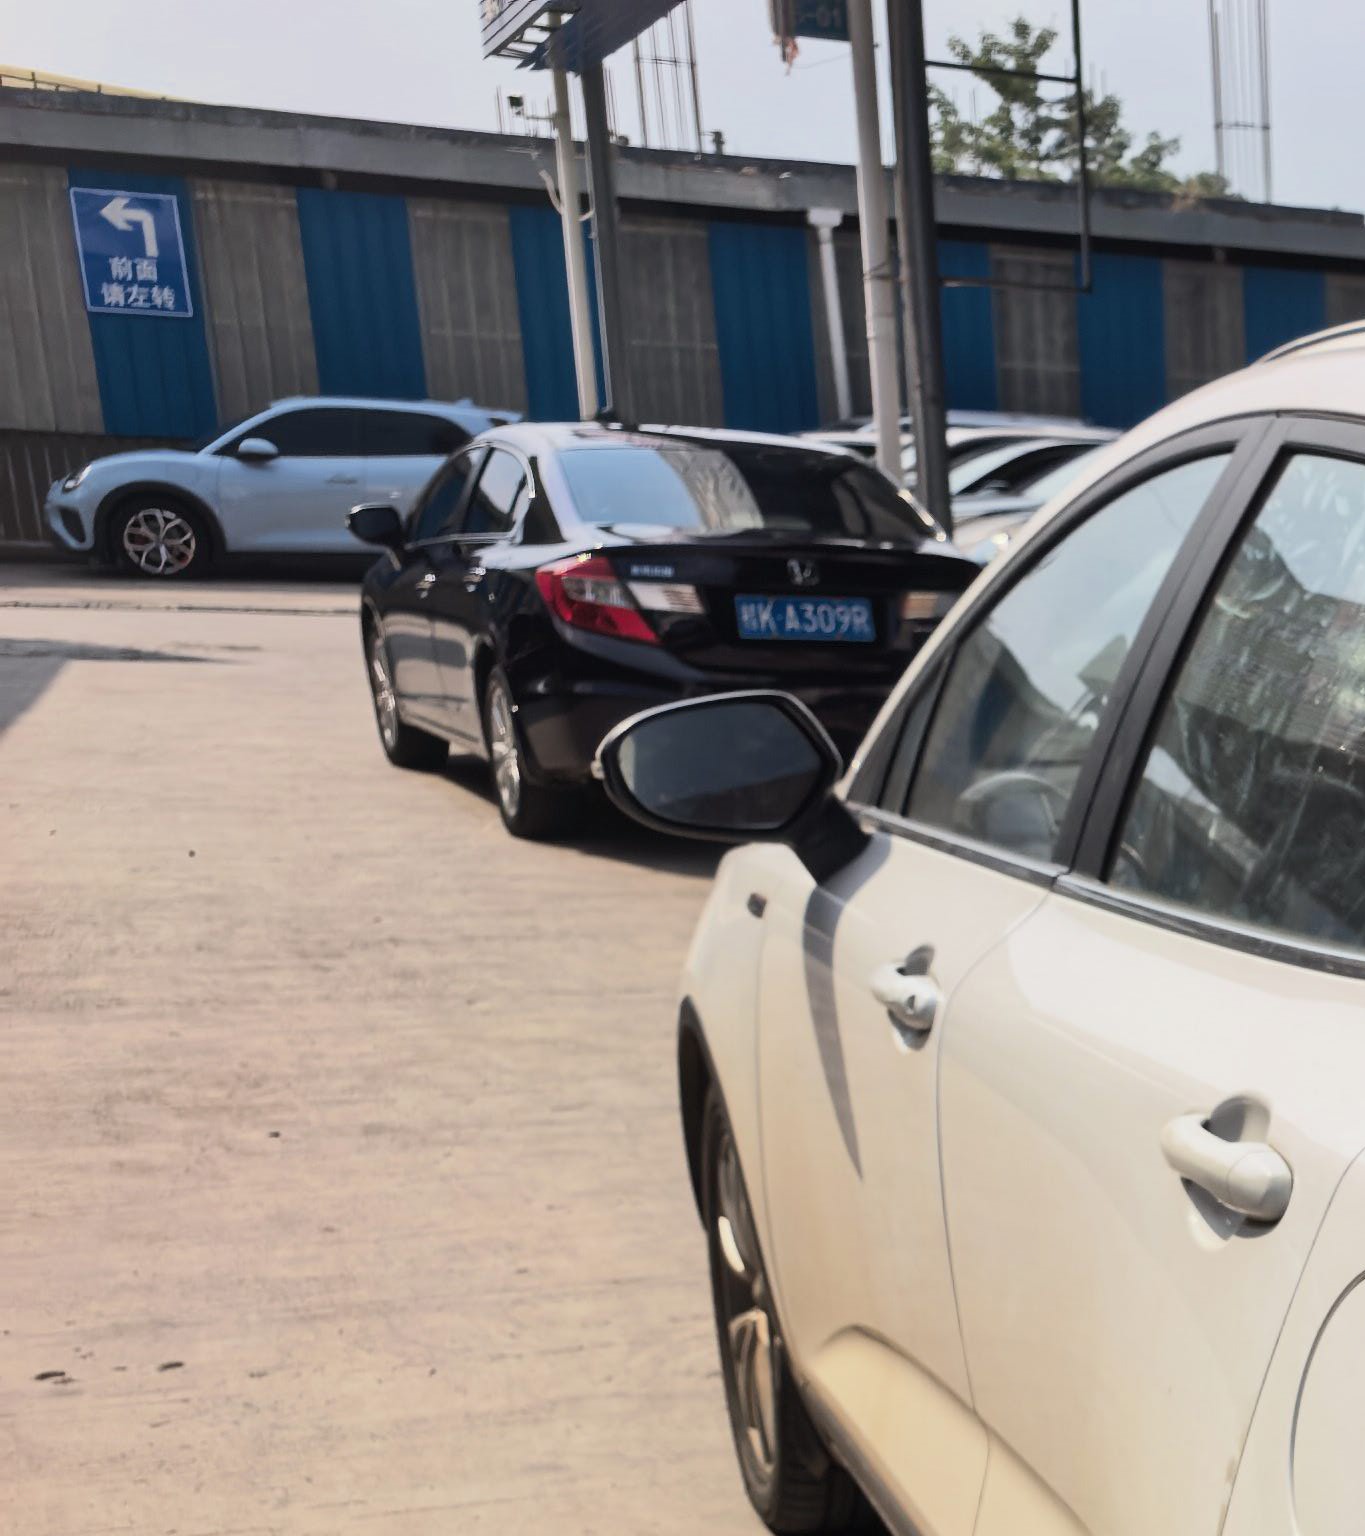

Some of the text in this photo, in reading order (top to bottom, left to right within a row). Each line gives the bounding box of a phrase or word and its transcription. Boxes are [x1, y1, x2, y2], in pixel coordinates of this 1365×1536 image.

[109, 256, 158, 281] 前面
[101, 282, 175, 311] 请左转
